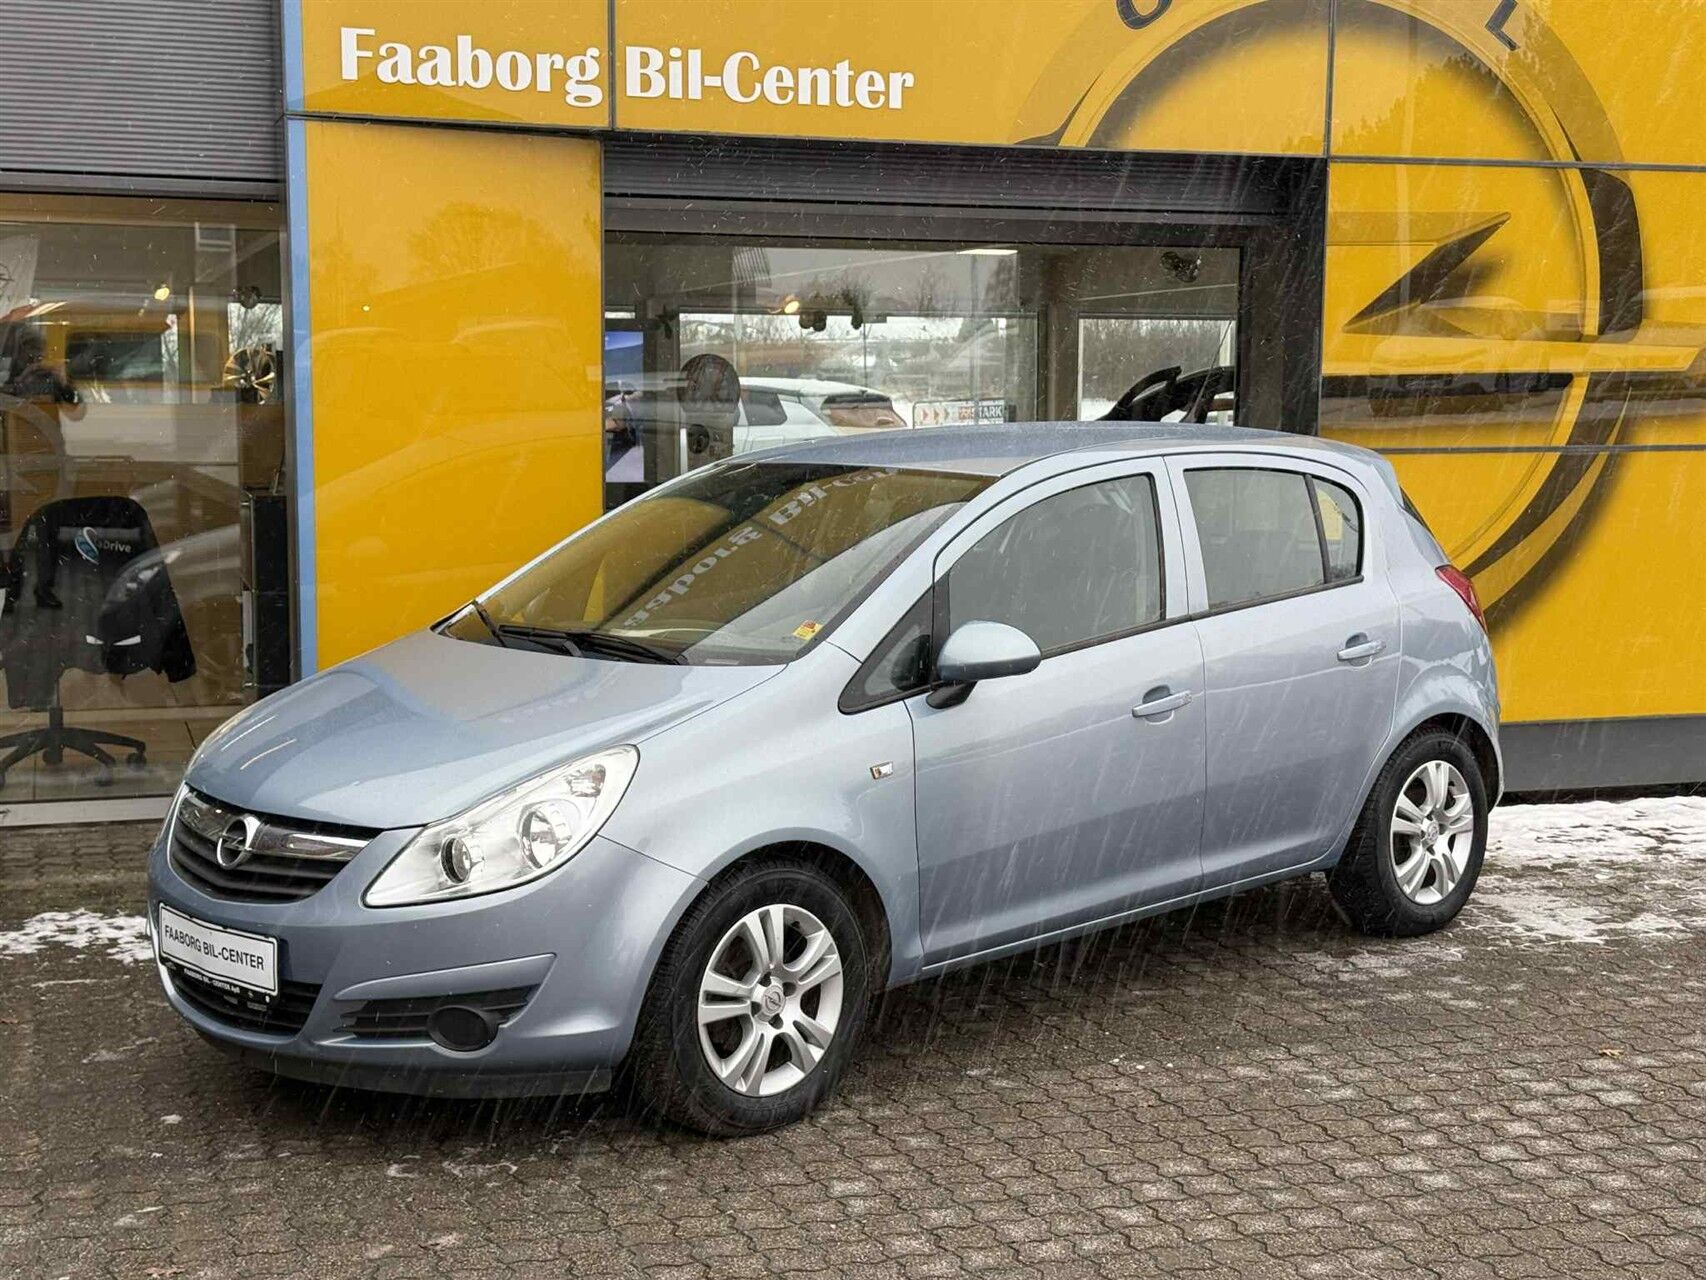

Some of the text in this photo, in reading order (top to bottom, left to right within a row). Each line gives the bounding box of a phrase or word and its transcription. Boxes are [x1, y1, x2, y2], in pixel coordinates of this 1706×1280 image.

[340, 26, 915, 109] Faaborg Bil-Center
[164, 924, 265, 971] FAABORG BIL-CENTER
